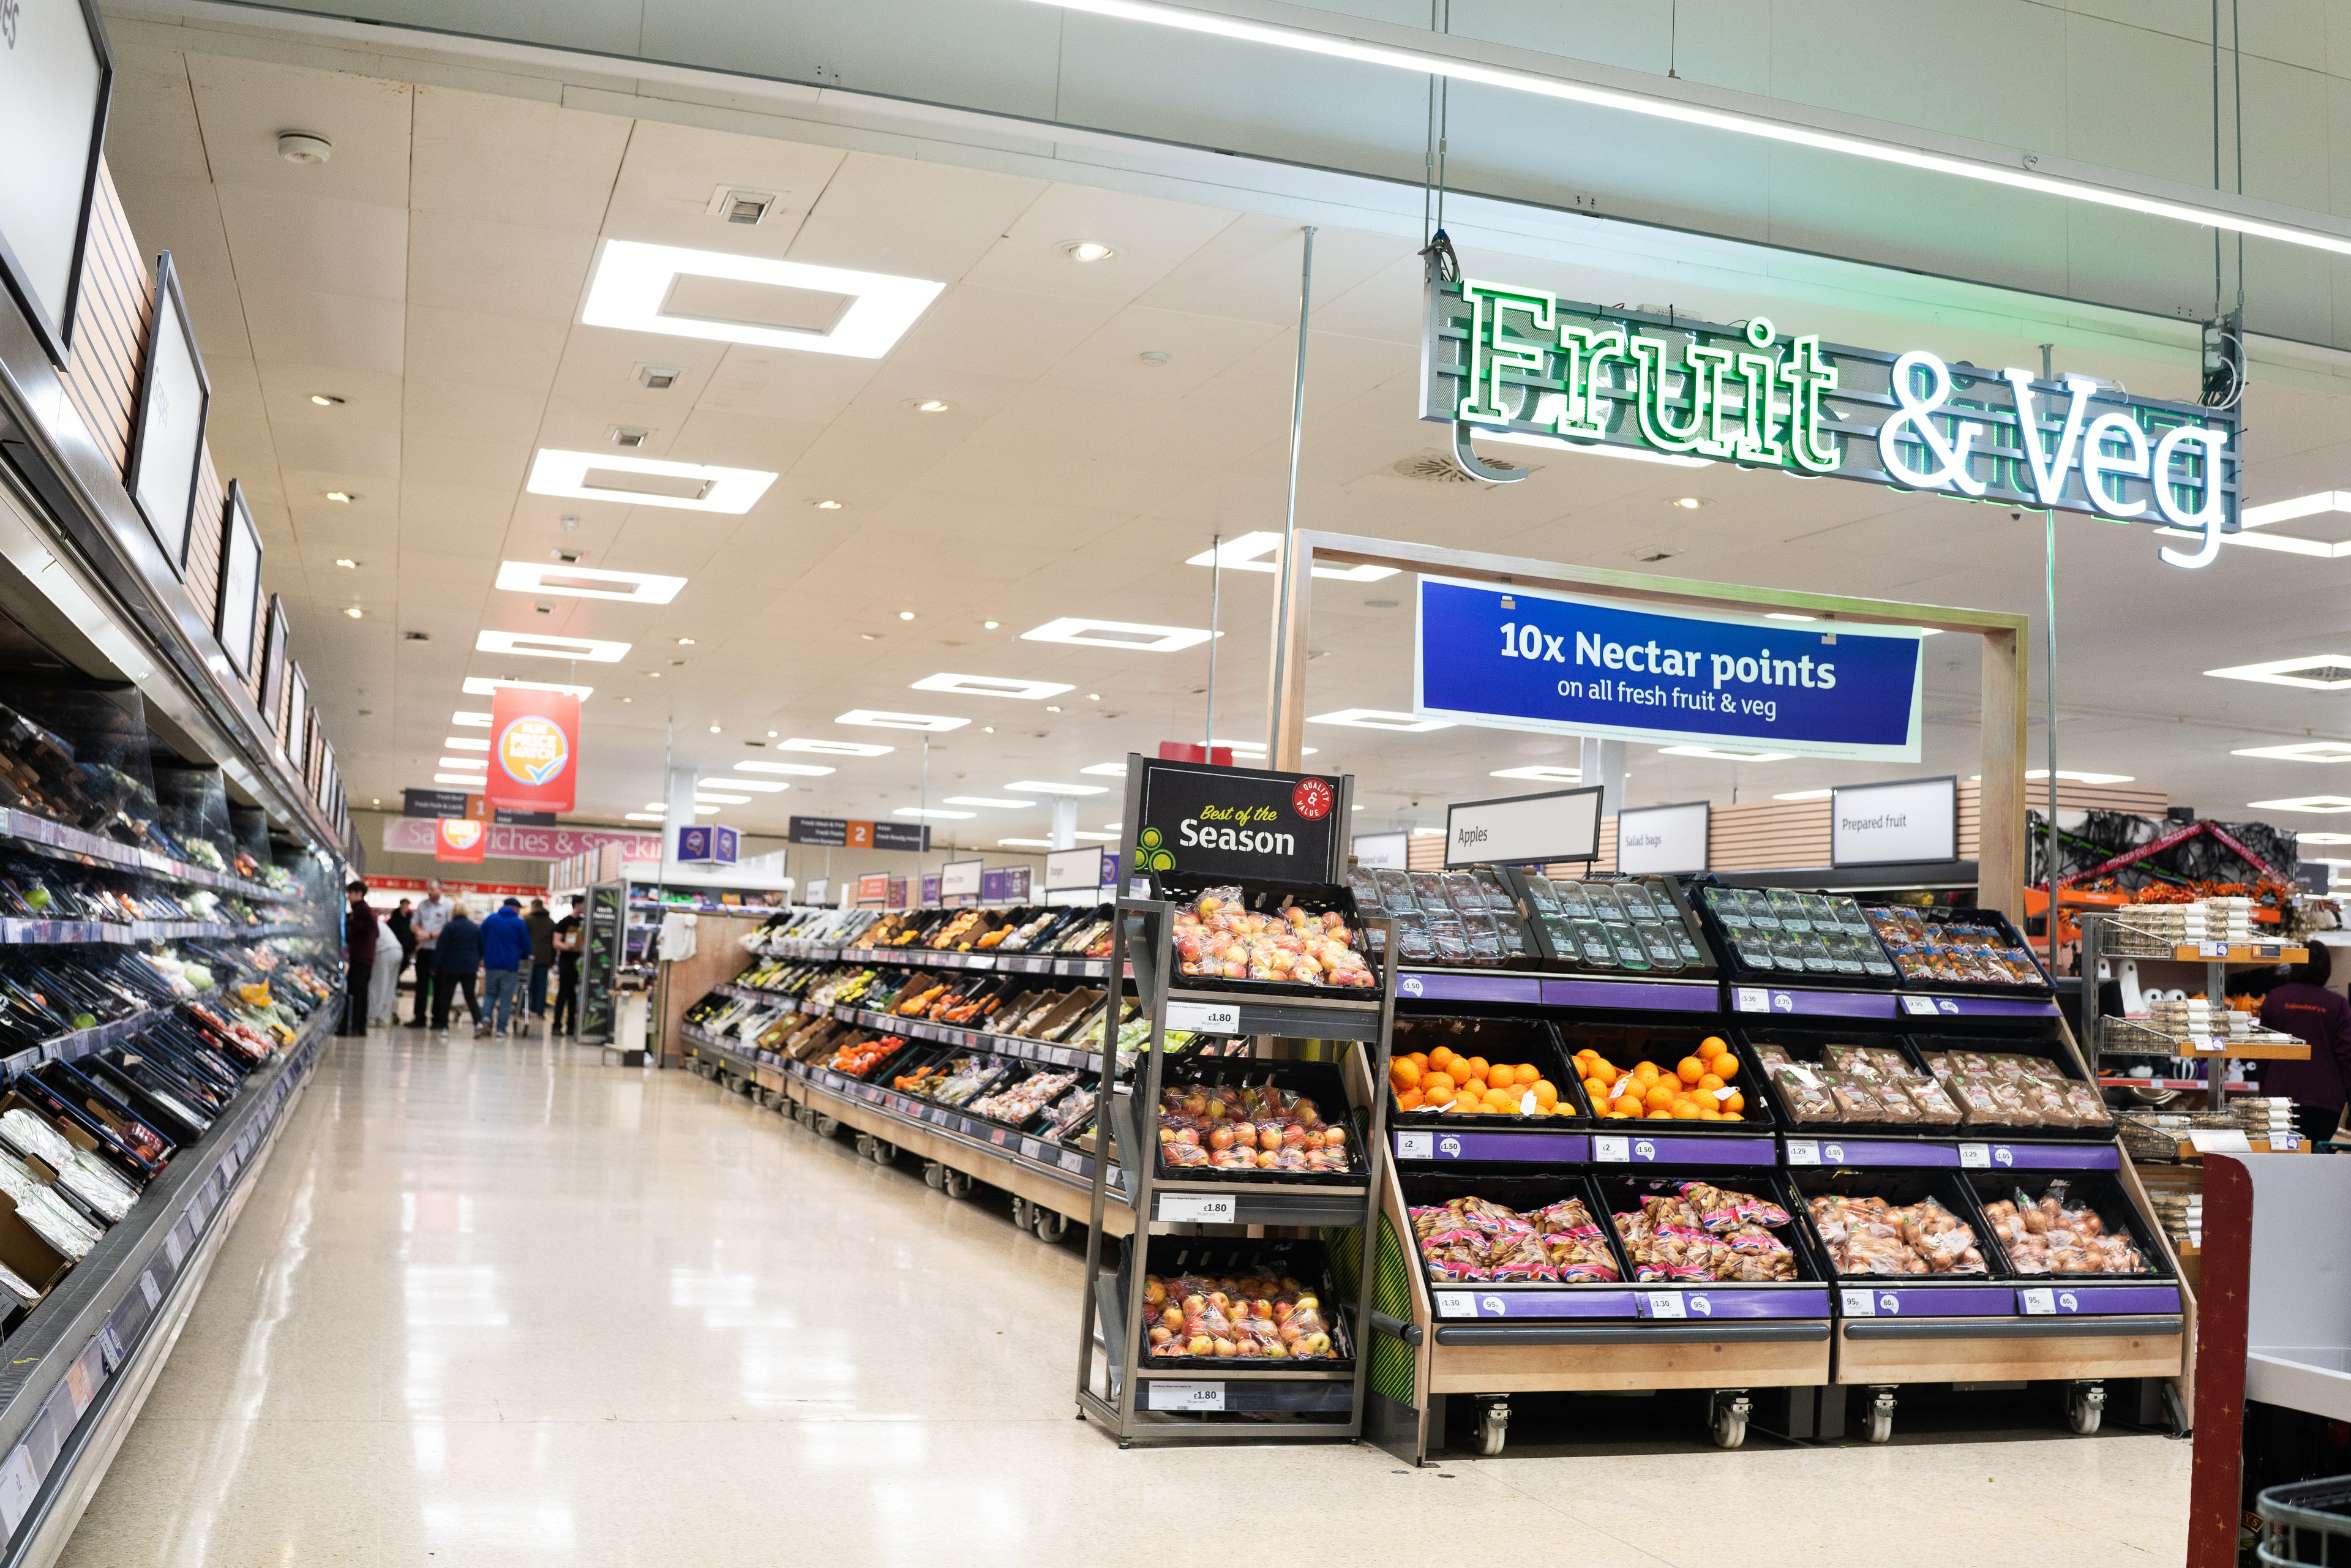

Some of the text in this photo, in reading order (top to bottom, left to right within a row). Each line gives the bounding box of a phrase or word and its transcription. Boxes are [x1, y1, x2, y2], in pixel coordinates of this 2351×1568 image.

[1460, 278, 2227, 568] Fruit & Veg
[1500, 623, 1836, 689] 10x Nectar points
[1558, 679, 1776, 721] on all fresh fruit & veg
[510, 732, 557, 748] PRICE
[509, 745, 557, 760] MATCH
[1303, 781, 1330, 801] QUALITY
[1308, 792, 1318, 806] &
[476, 800, 484, 816] 1
[1200, 805, 1277, 827] Best of the
[1296, 800, 1319, 817] VALUE
[1842, 814, 1907, 833] Prepared fruit
[555, 831, 575, 853] &
[855, 827, 866, 842] 2
[1180, 819, 1294, 855] Season
[1458, 825, 1488, 847] Apples
[1625, 834, 1662, 848] Salad bags
[1208, 1013, 1231, 1022] £1.80
[1204, 1203, 1227, 1212] £1.80
[1194, 1391, 1217, 1400] £1.80
